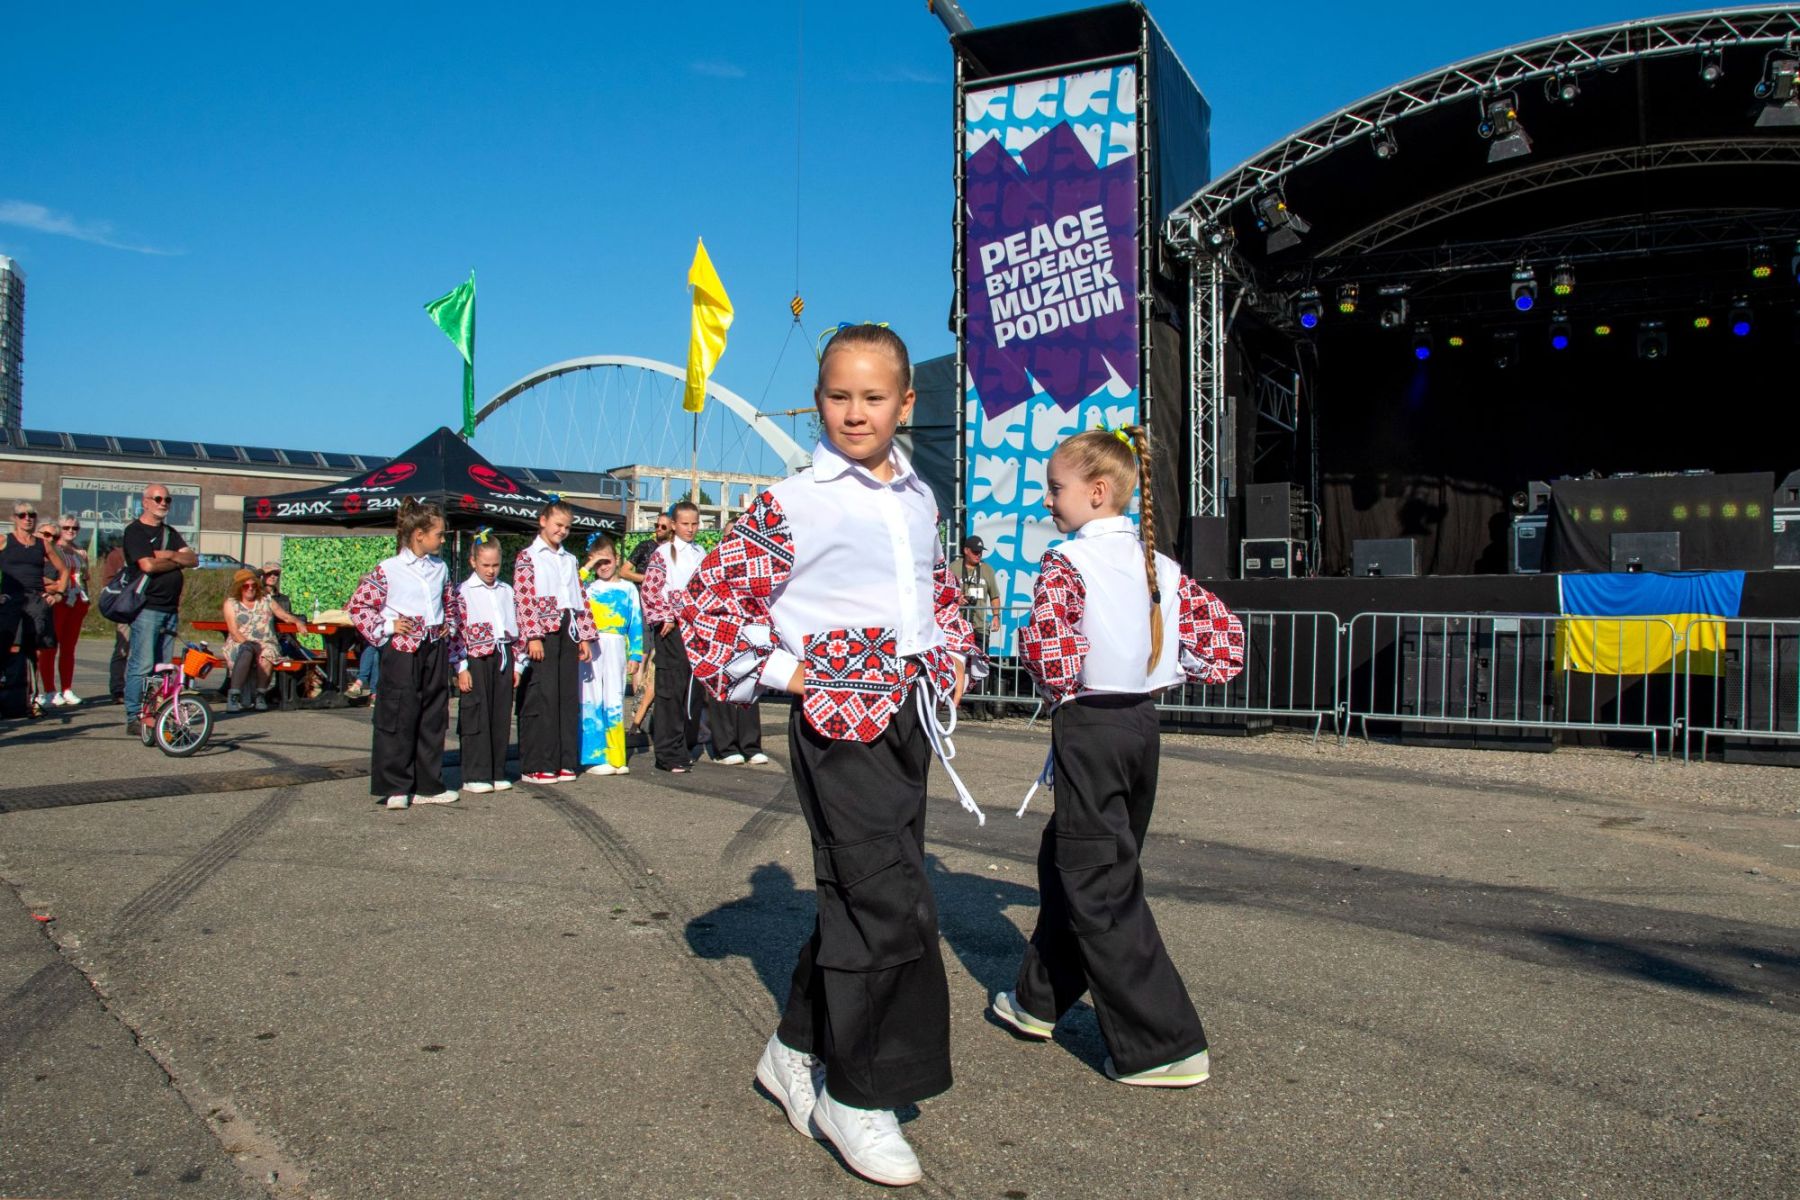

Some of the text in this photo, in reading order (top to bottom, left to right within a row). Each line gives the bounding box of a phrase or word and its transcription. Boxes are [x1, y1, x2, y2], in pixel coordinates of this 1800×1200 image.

[980, 204, 1108, 275] PEACE
[1022, 236, 1113, 284] PEACE
[989, 259, 1119, 323] MUZIEK
[994, 285, 1124, 349] PODIUM
[276, 500, 334, 517] 24MX
